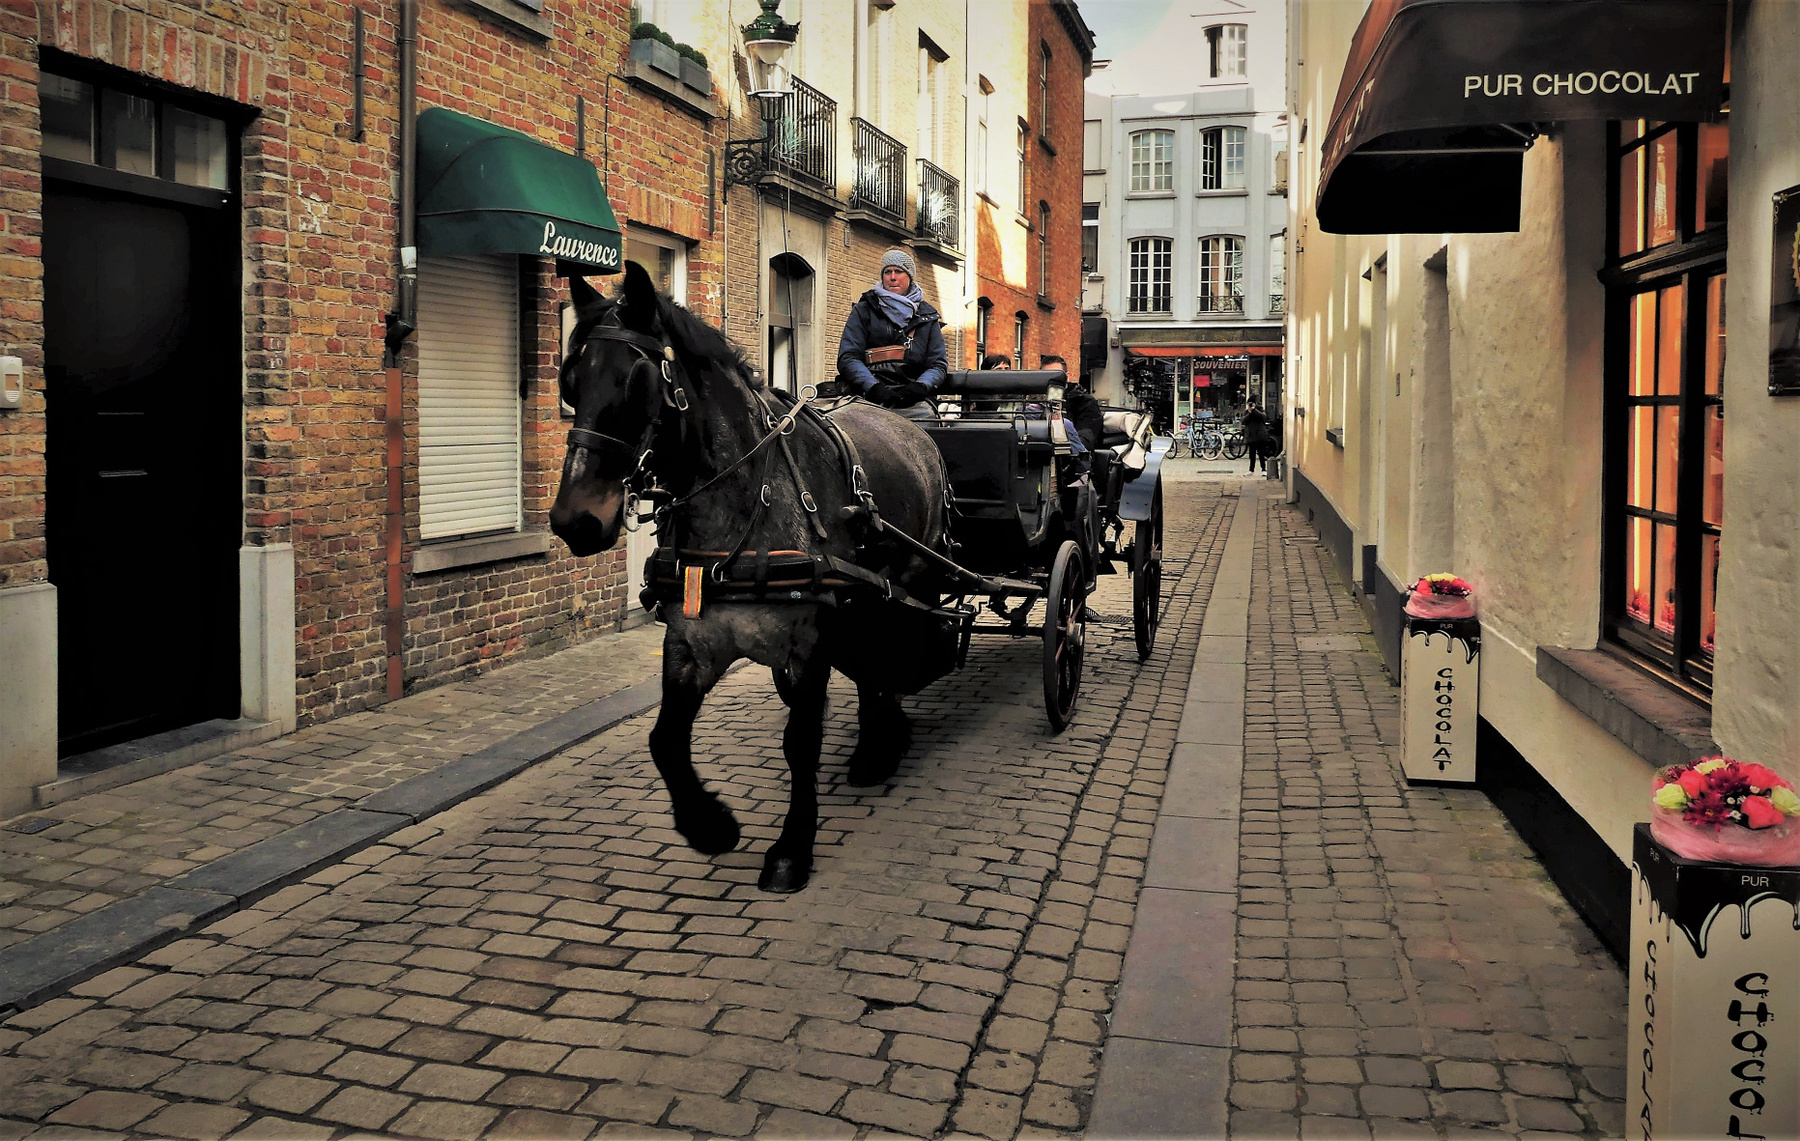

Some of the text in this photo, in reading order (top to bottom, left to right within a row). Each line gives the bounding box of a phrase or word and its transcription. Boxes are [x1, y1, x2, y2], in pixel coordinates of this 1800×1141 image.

[1463, 70, 1700, 98] PUR CHOCOLAT
[540, 221, 618, 266] Laurence
[1432, 667, 1456, 773] CHOCOLAT
[1741, 874, 1769, 888] PUR
